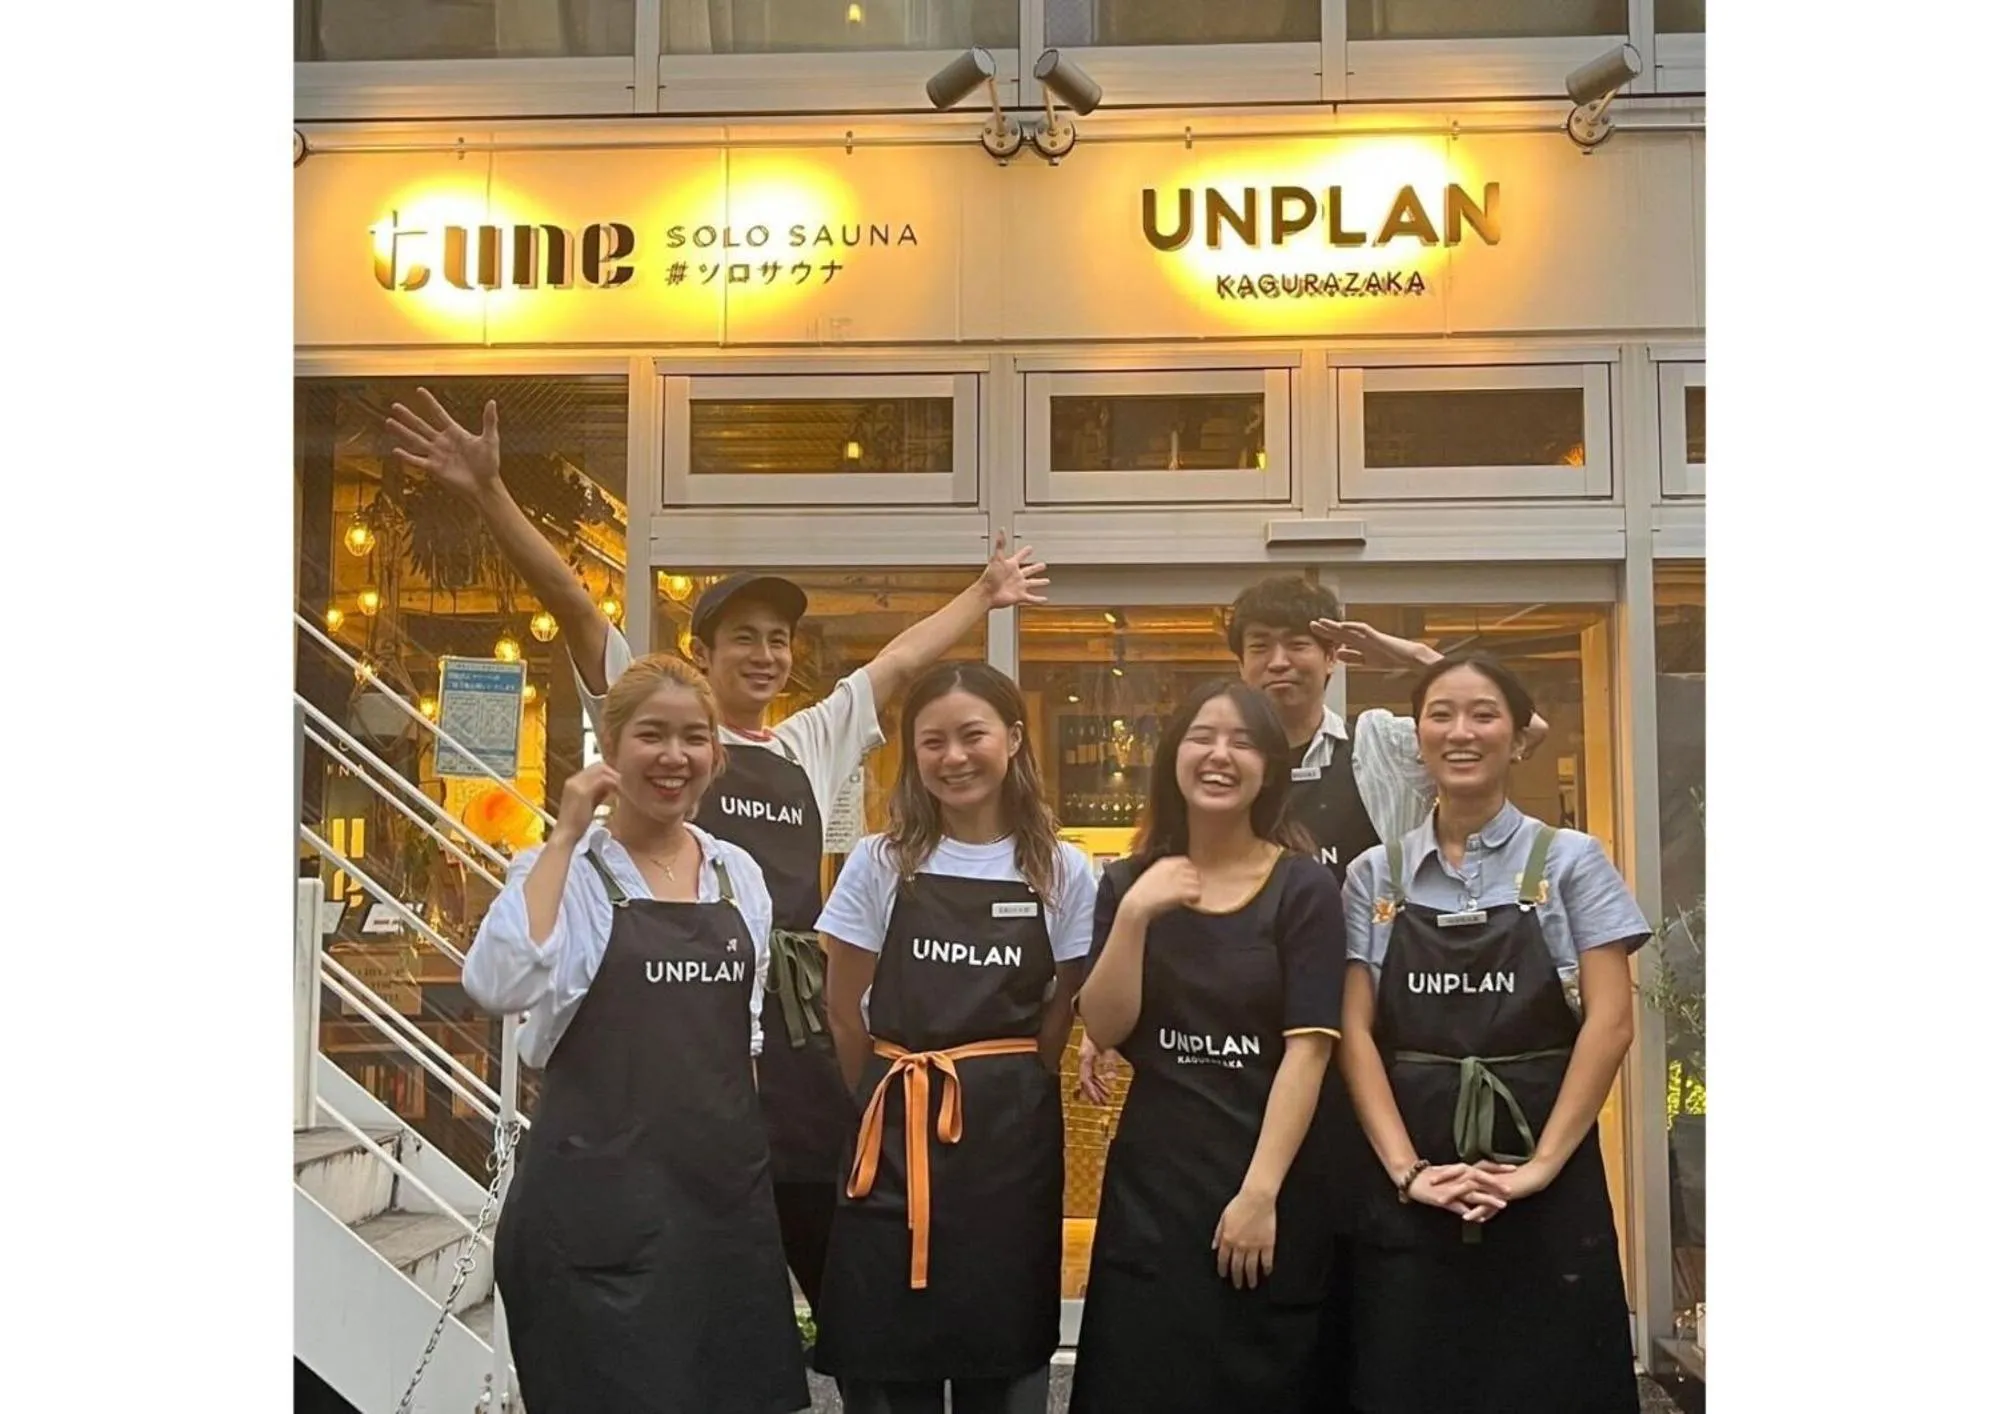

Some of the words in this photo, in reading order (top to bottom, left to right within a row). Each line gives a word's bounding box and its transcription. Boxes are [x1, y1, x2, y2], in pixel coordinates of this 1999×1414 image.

[1142, 181, 1500, 251] UNPLAN
[666, 224, 770, 249] SOLO
[788, 223, 918, 247] SAUNA
[369, 210, 634, 291] tune
[665, 259, 843, 287] #ソロサウナ
[1216, 271, 1425, 300] KAGURAZAKA
[720, 796, 803, 827] UNPLAN
[912, 938, 1022, 967] UNPLAN
[645, 961, 745, 983] UNPLAN
[1408, 971, 1515, 994] UNPLAN
[1160, 1028, 1260, 1056] UNPLAN
